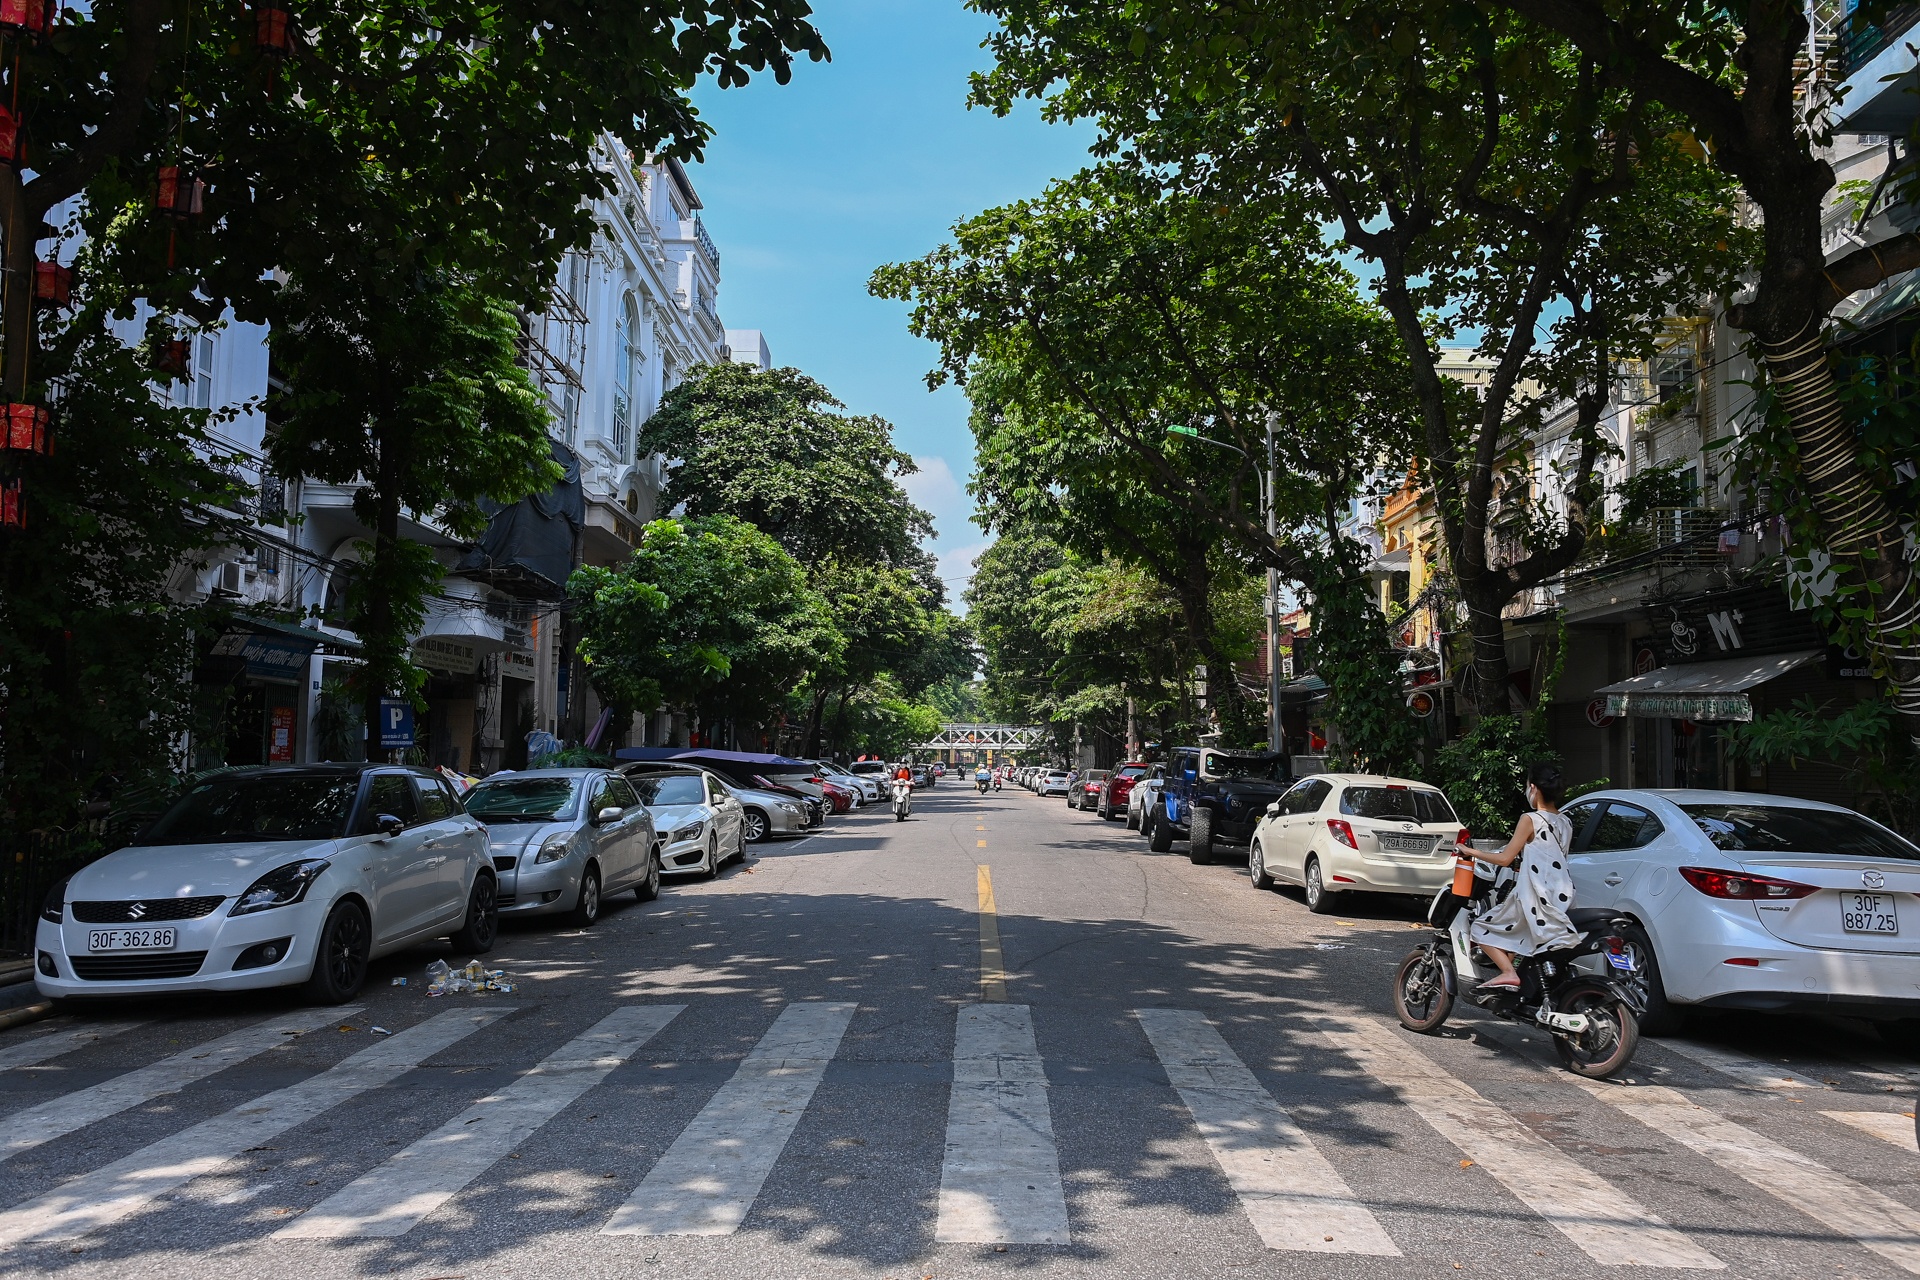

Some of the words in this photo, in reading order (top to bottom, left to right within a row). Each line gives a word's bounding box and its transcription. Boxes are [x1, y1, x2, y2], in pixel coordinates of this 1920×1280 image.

[391, 708, 403, 729] P
[1854, 895, 1881, 912] 30F
[1845, 912, 1895, 931] 887.25
[91, 930, 172, 948] 30F-362.86
